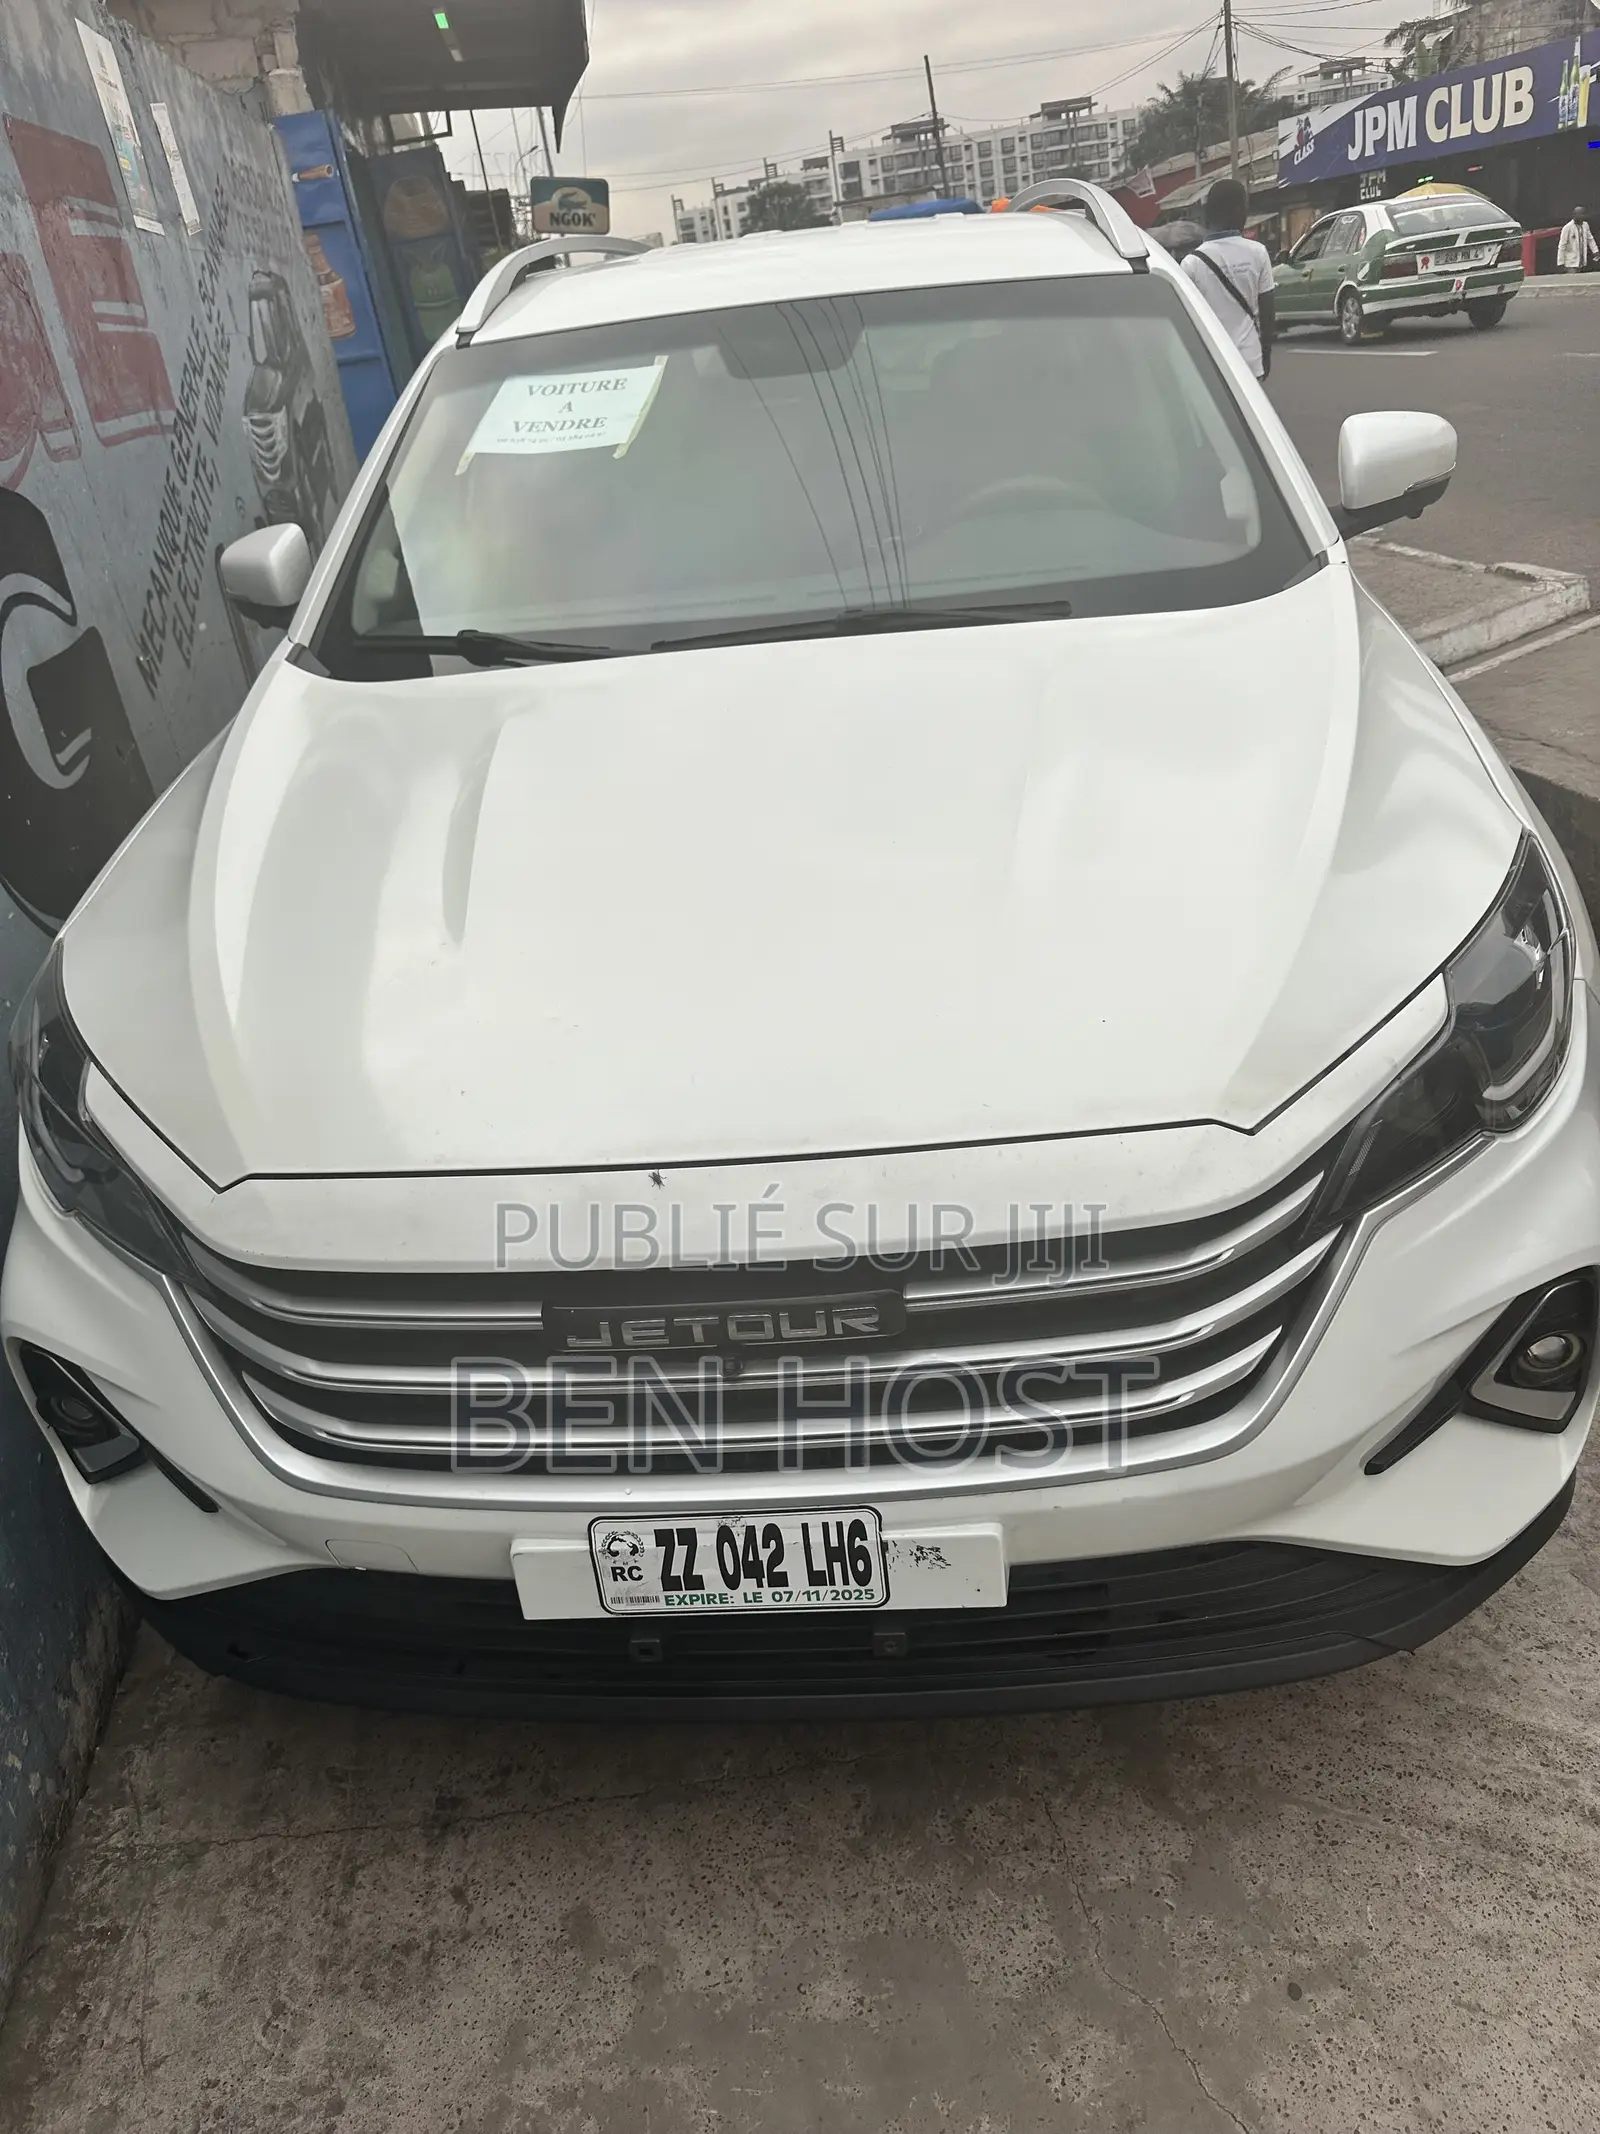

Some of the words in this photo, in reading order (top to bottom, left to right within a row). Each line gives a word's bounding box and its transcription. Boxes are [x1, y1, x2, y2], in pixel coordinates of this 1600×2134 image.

[1348, 95, 1418, 161] JPM
[1425, 66, 1534, 143] CLUB
[1294, 138, 1315, 165] CLASS
[526, 378, 628, 396] VOITURE
[558, 401, 574, 413] A
[512, 417, 608, 433] VENDRE
[137, 465, 185, 700] MECANIQUE
[566, 1306, 880, 1347] JETOUR
[653, 1527, 706, 1592] ZZ
[716, 1522, 789, 1591] 042
[800, 1518, 873, 1587] LH6
[611, 1565, 644, 1583] RC
[664, 1593, 734, 1607] EXPIRE:
[743, 1591, 763, 1604] LE
[771, 1588, 876, 1603] 07/11/2025
